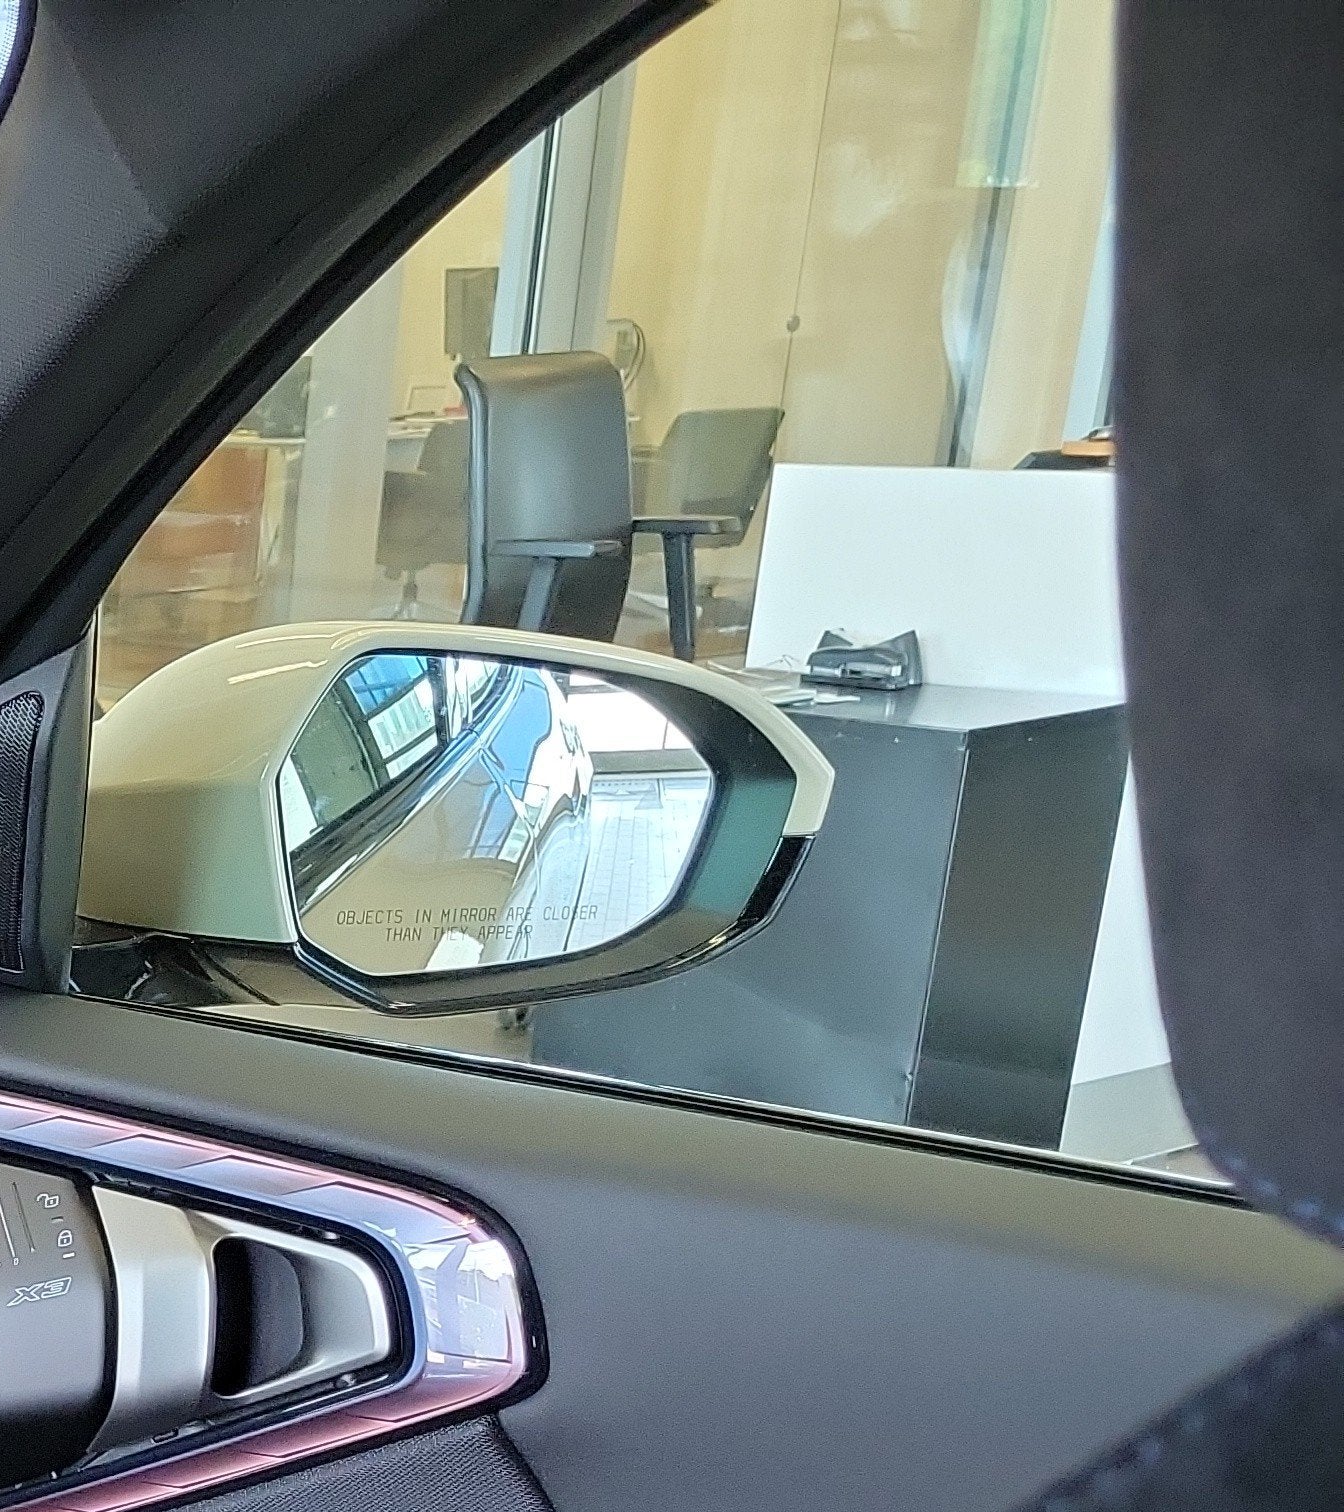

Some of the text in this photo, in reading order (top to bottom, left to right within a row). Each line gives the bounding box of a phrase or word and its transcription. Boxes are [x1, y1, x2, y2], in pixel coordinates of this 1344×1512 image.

[336, 905, 599, 926] OBJECTS IN MIRROR ARE CLOSER
[386, 925, 534, 942] THAN THEY APPEAR
[6, 1276, 73, 1307] X3
